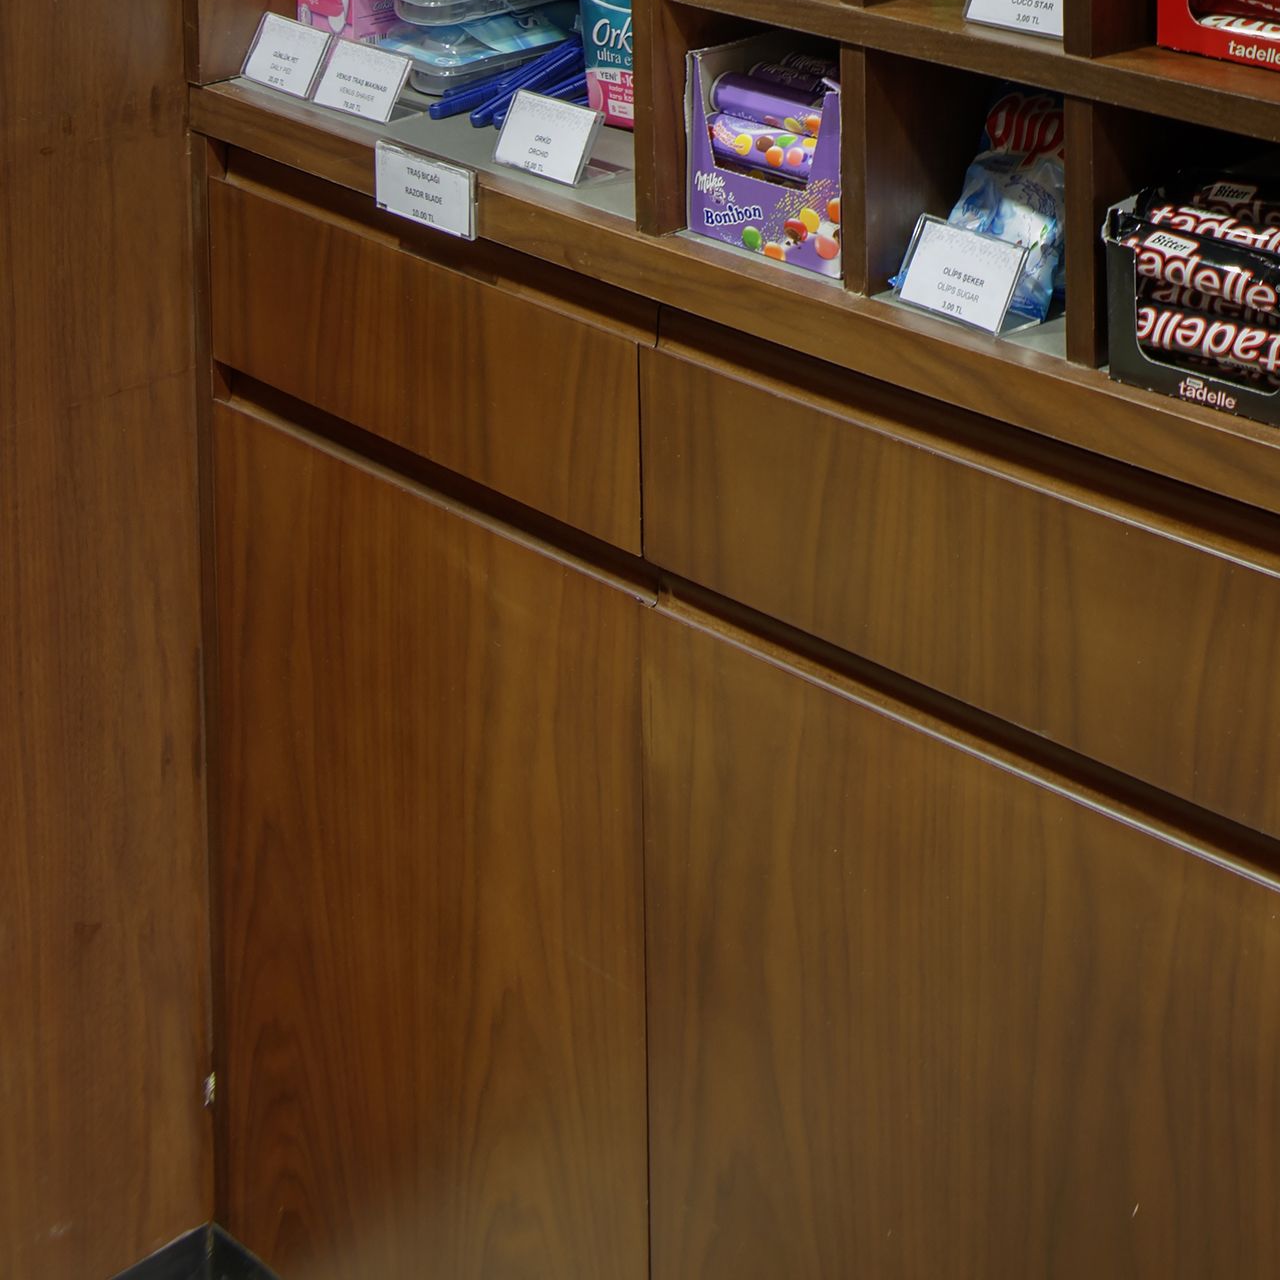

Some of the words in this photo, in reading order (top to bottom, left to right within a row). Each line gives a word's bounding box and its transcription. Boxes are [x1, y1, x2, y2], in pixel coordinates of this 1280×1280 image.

[1032, 0, 1054, 11] STAR
[597, 49, 621, 65] ultra
[694, 170, 725, 192] Milka
[405, 186, 424, 199] RAZOR
[424, 191, 442, 205] BLADE
[704, 204, 763, 226] Bonibon
[1151, 233, 1190, 254] Bitter
[944, 266, 961, 279] OLİPS
[962, 272, 985, 287] ŞEKER
[1178, 380, 1235, 410] tadelle
